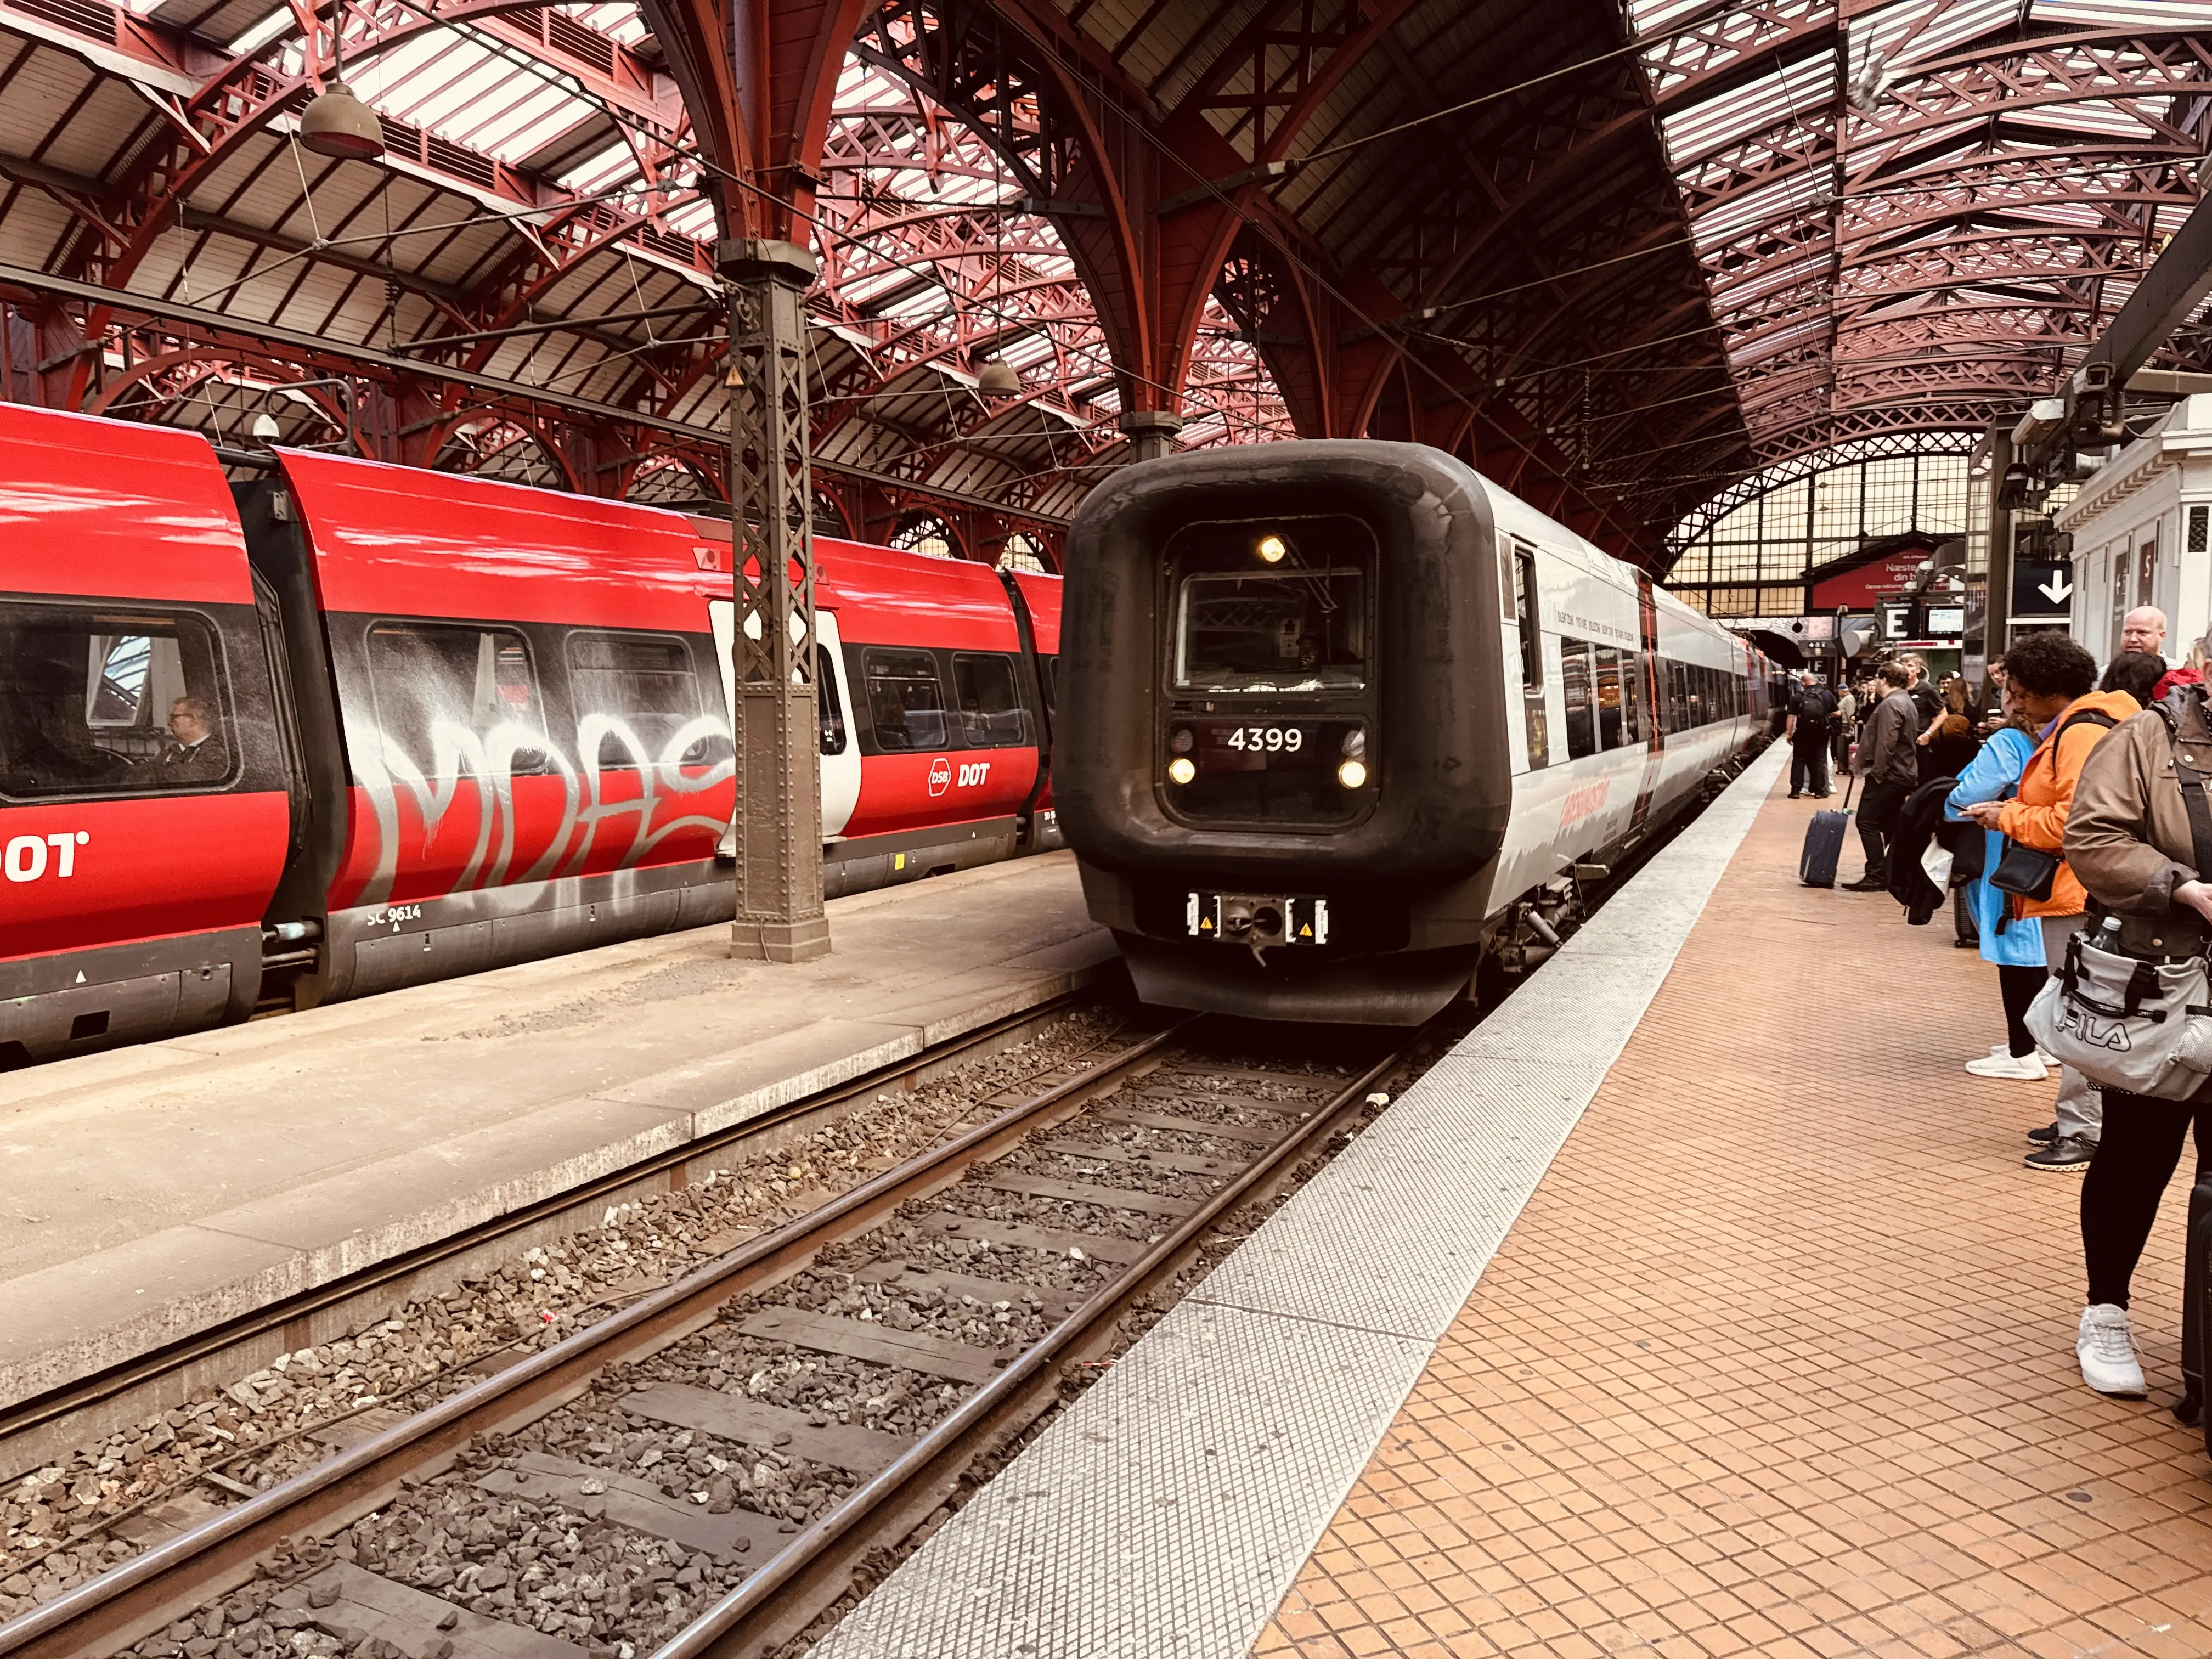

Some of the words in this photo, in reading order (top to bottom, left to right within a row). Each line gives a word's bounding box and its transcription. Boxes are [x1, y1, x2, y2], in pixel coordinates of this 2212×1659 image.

[1886, 563, 1917, 572] Næste
[1894, 573, 1908, 582] din
[1886, 609, 1909, 637] E
[1814, 661, 1824, 672] F
[1227, 727, 1302, 752] 4399
[931, 771, 949, 785] DSB
[957, 762, 990, 787] DOT
[0, 831, 90, 882] OT
[367, 912, 385, 926] SC
[388, 904, 421, 923] 9614
[2056, 1009, 2131, 1052] FILA
